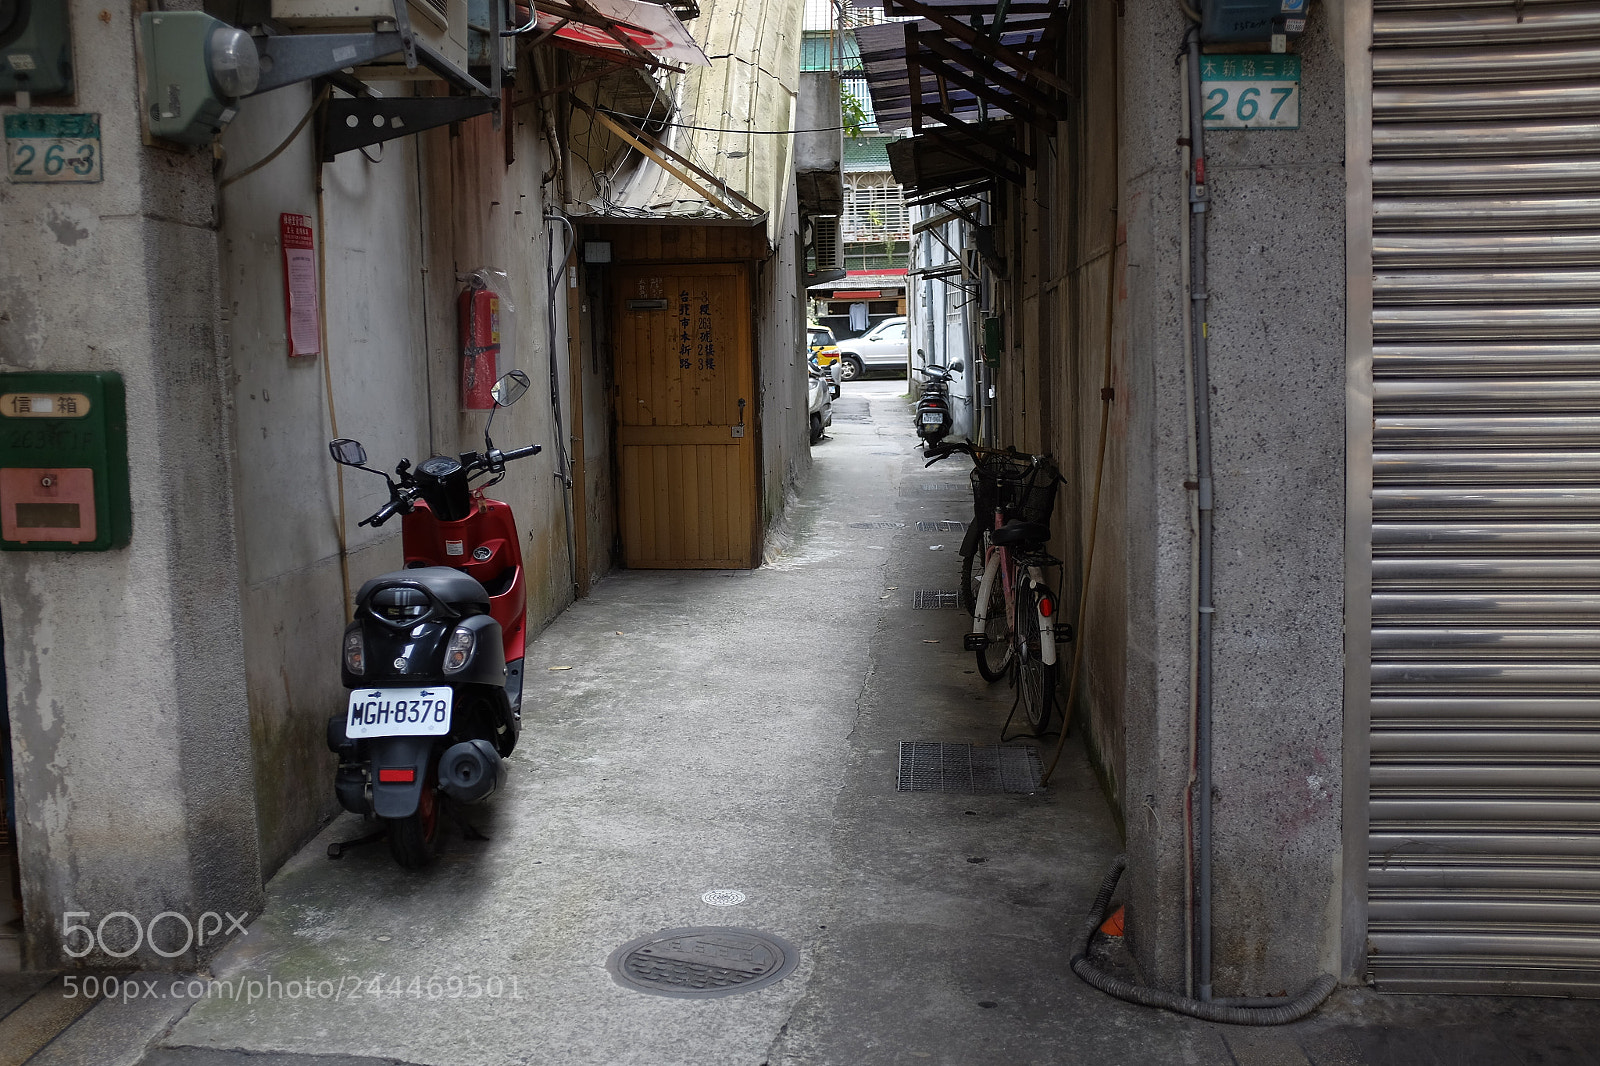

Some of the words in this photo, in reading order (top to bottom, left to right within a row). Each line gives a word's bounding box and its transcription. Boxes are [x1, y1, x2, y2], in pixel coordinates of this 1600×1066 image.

[1202, 59, 1297, 77] 木新路三段
[1202, 87, 1294, 121] 267
[14, 144, 95, 176] 263
